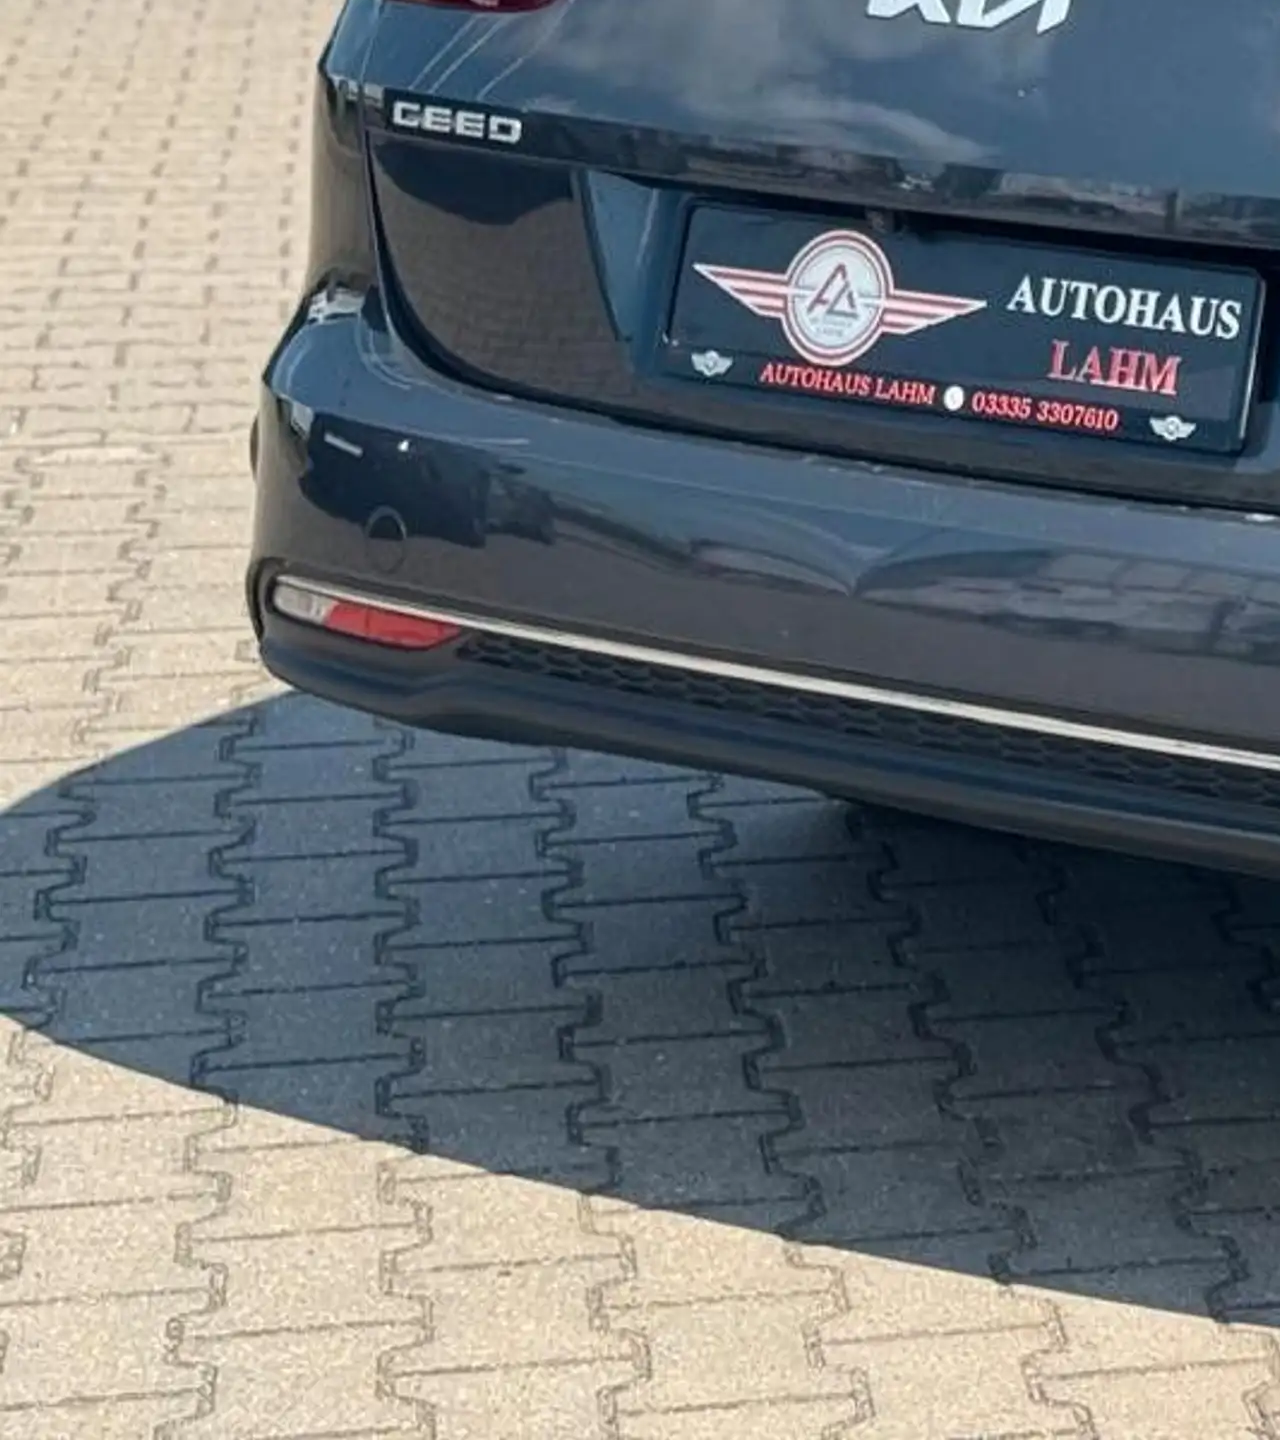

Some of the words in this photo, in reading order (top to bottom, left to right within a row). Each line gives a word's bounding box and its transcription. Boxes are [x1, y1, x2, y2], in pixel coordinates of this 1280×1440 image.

[1006, 273, 1242, 340] AUTOHAUS
[760, 363, 870, 397] AUTOHAUS
[873, 378, 936, 406] LAHM
[971, 391, 1032, 420] 03335
[1036, 402, 1120, 431] 3307610
[1047, 338, 1182, 397] LAHM
